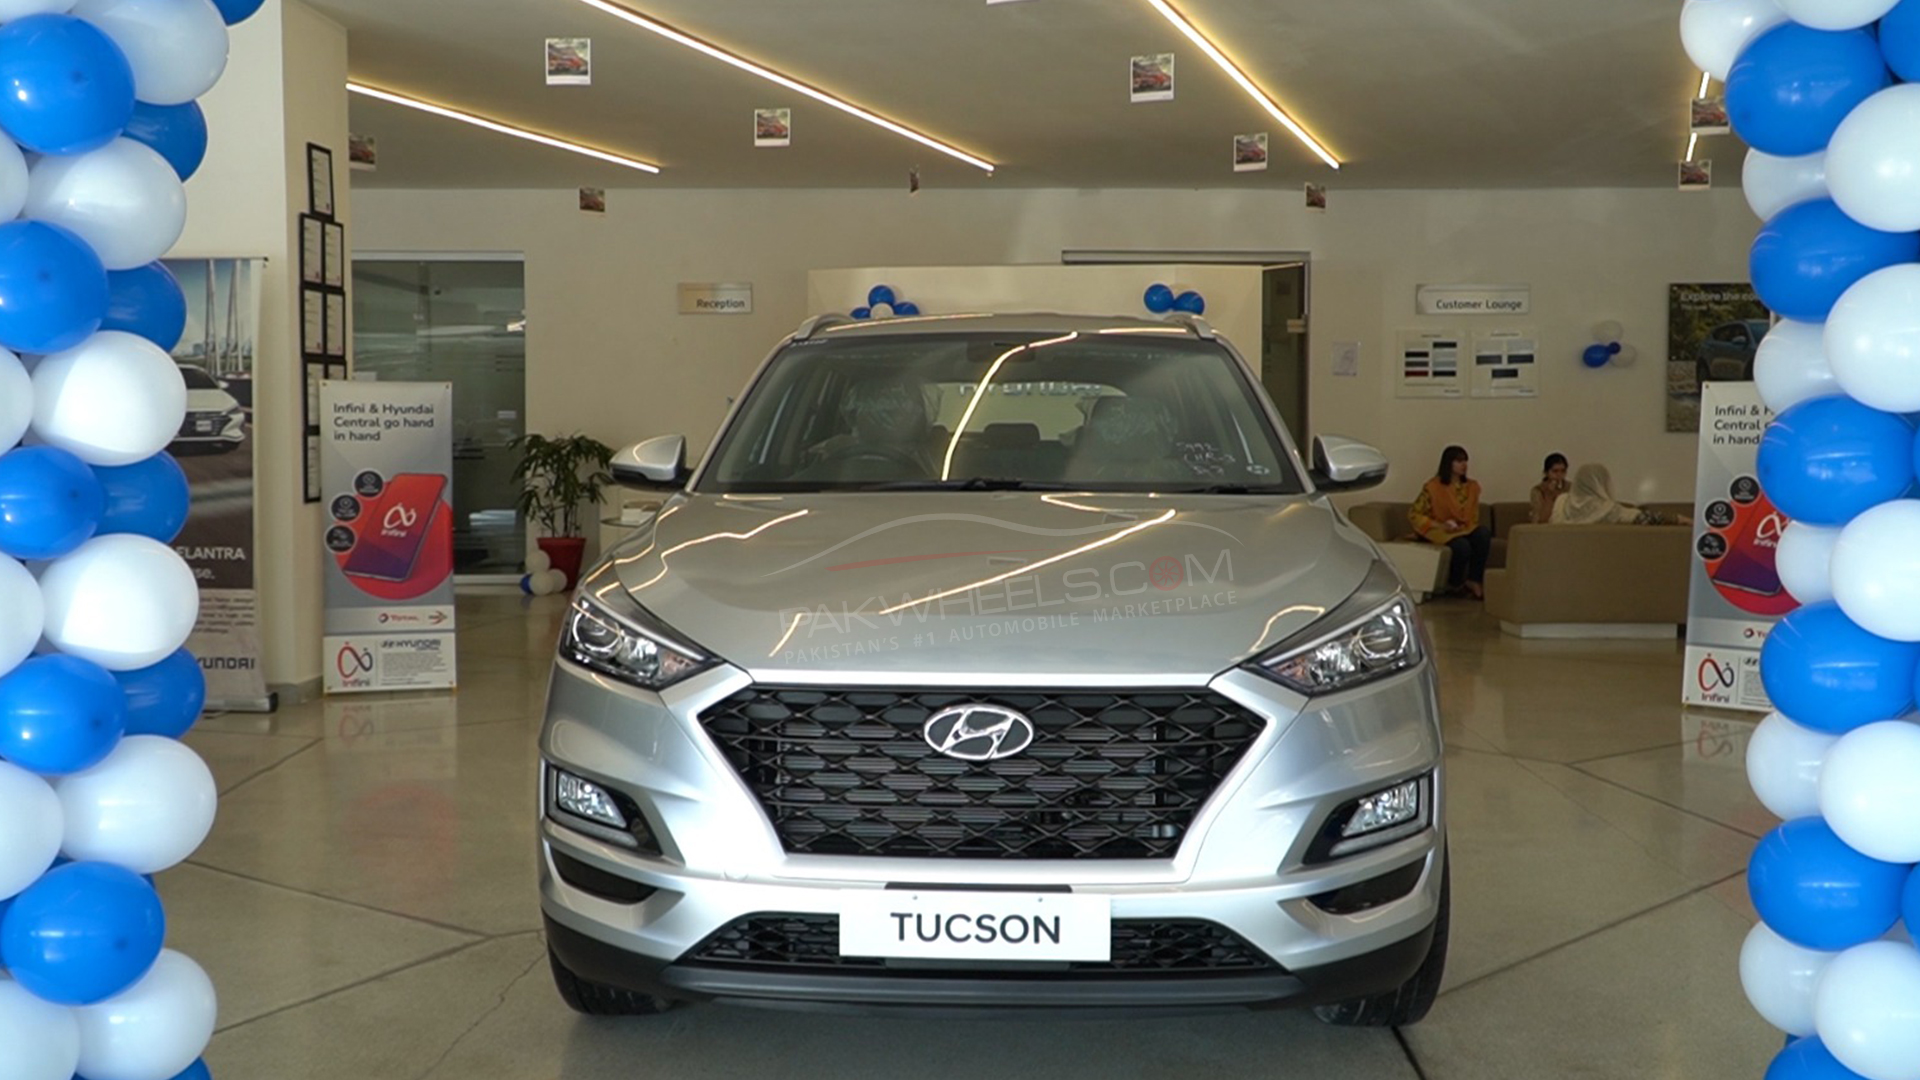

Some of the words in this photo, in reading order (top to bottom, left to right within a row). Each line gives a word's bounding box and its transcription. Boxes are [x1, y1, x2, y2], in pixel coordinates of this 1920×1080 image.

[696, 299, 745, 309] Reception
[1436, 299, 1482, 309] Customer
[1486, 299, 1522, 311] Lounge
[334, 403, 365, 413] Infini
[369, 404, 378, 414] &
[383, 404, 434, 415] Hyundai
[1715, 405, 1747, 416] Infini
[1750, 405, 1759, 416] &
[333, 416, 380, 428] Central
[384, 420, 400, 429] go
[404, 418, 434, 428] hand
[1714, 419, 1760, 430] Central
[334, 431, 345, 441] in
[349, 431, 381, 441] hand
[1713, 434, 1724, 444] in
[1728, 434, 1760, 445] hand
[890, 912, 1061, 945] TUCSON
